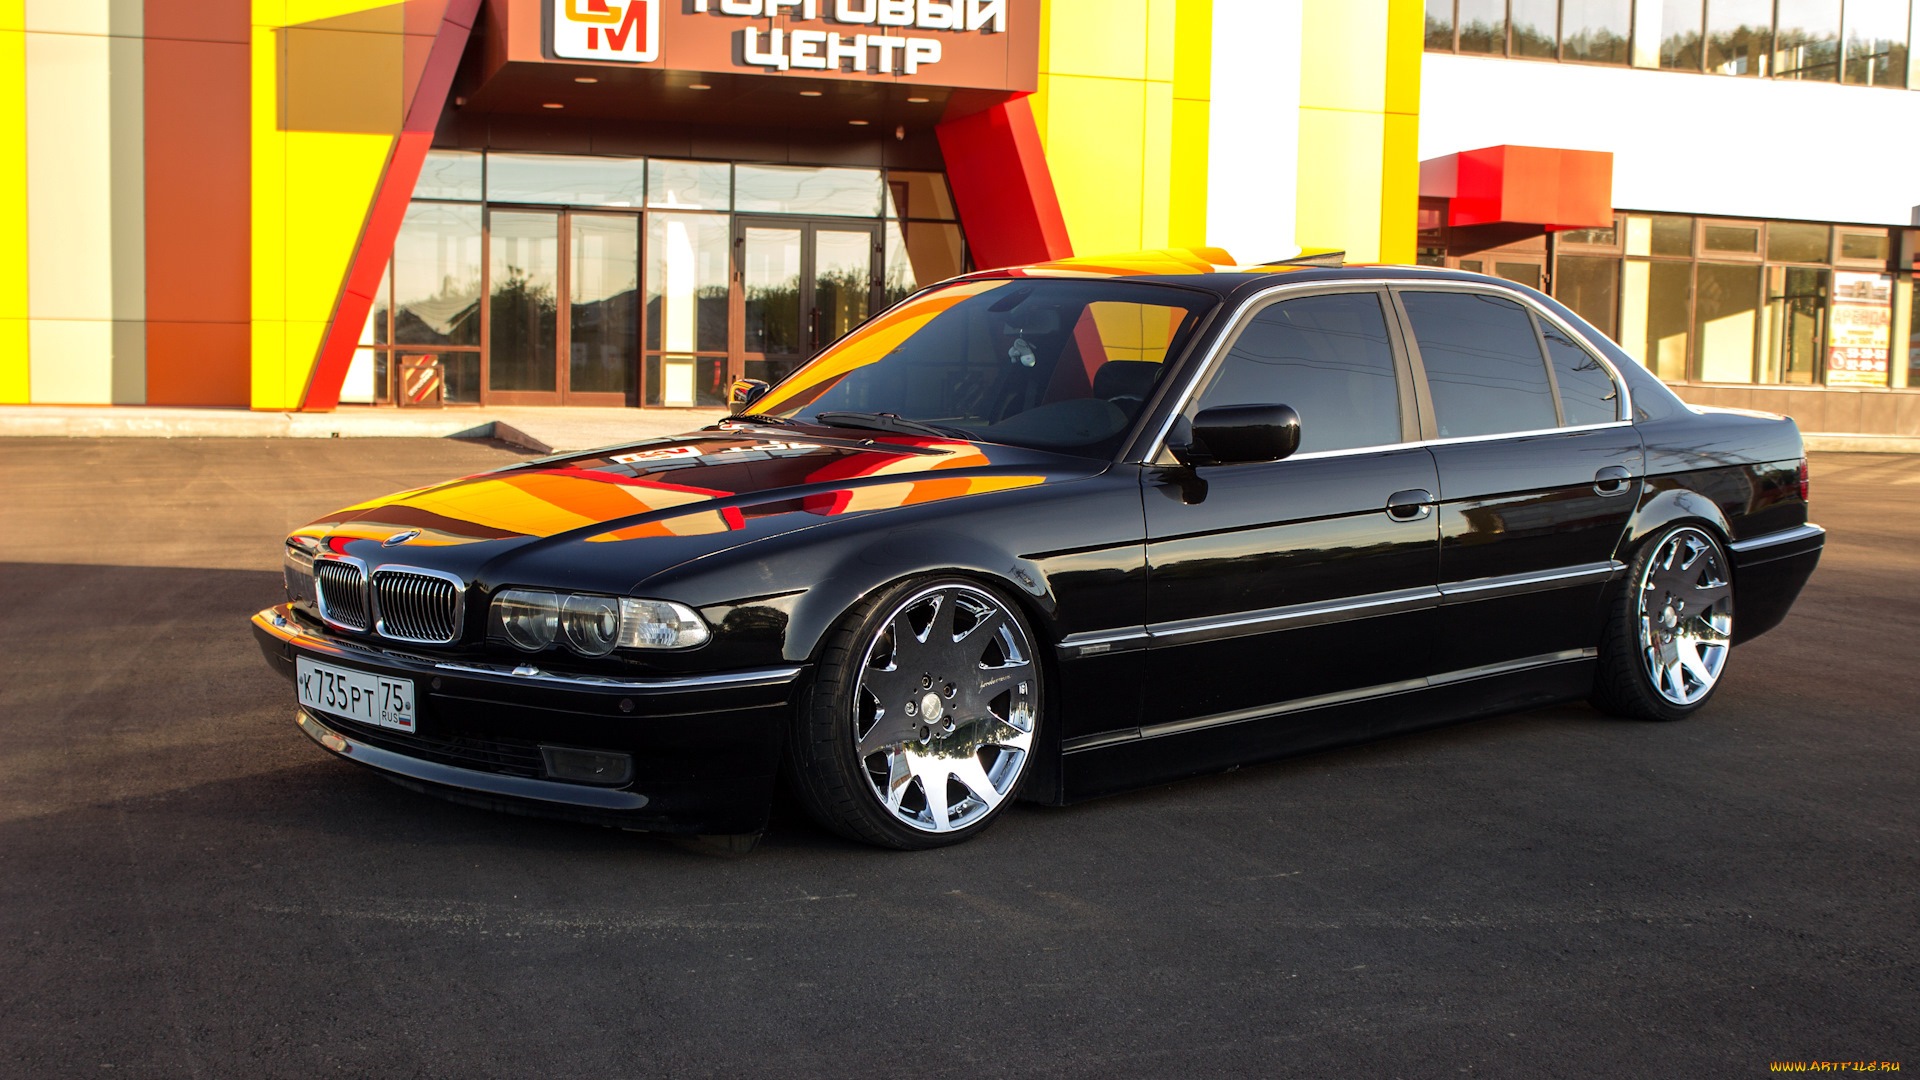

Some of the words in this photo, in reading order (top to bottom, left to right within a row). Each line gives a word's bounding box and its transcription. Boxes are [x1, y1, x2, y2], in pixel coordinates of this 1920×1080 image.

[745, 26, 942, 75] ЦЕНТР
[381, 682, 404, 712] 75
[382, 710, 399, 724] RUS
